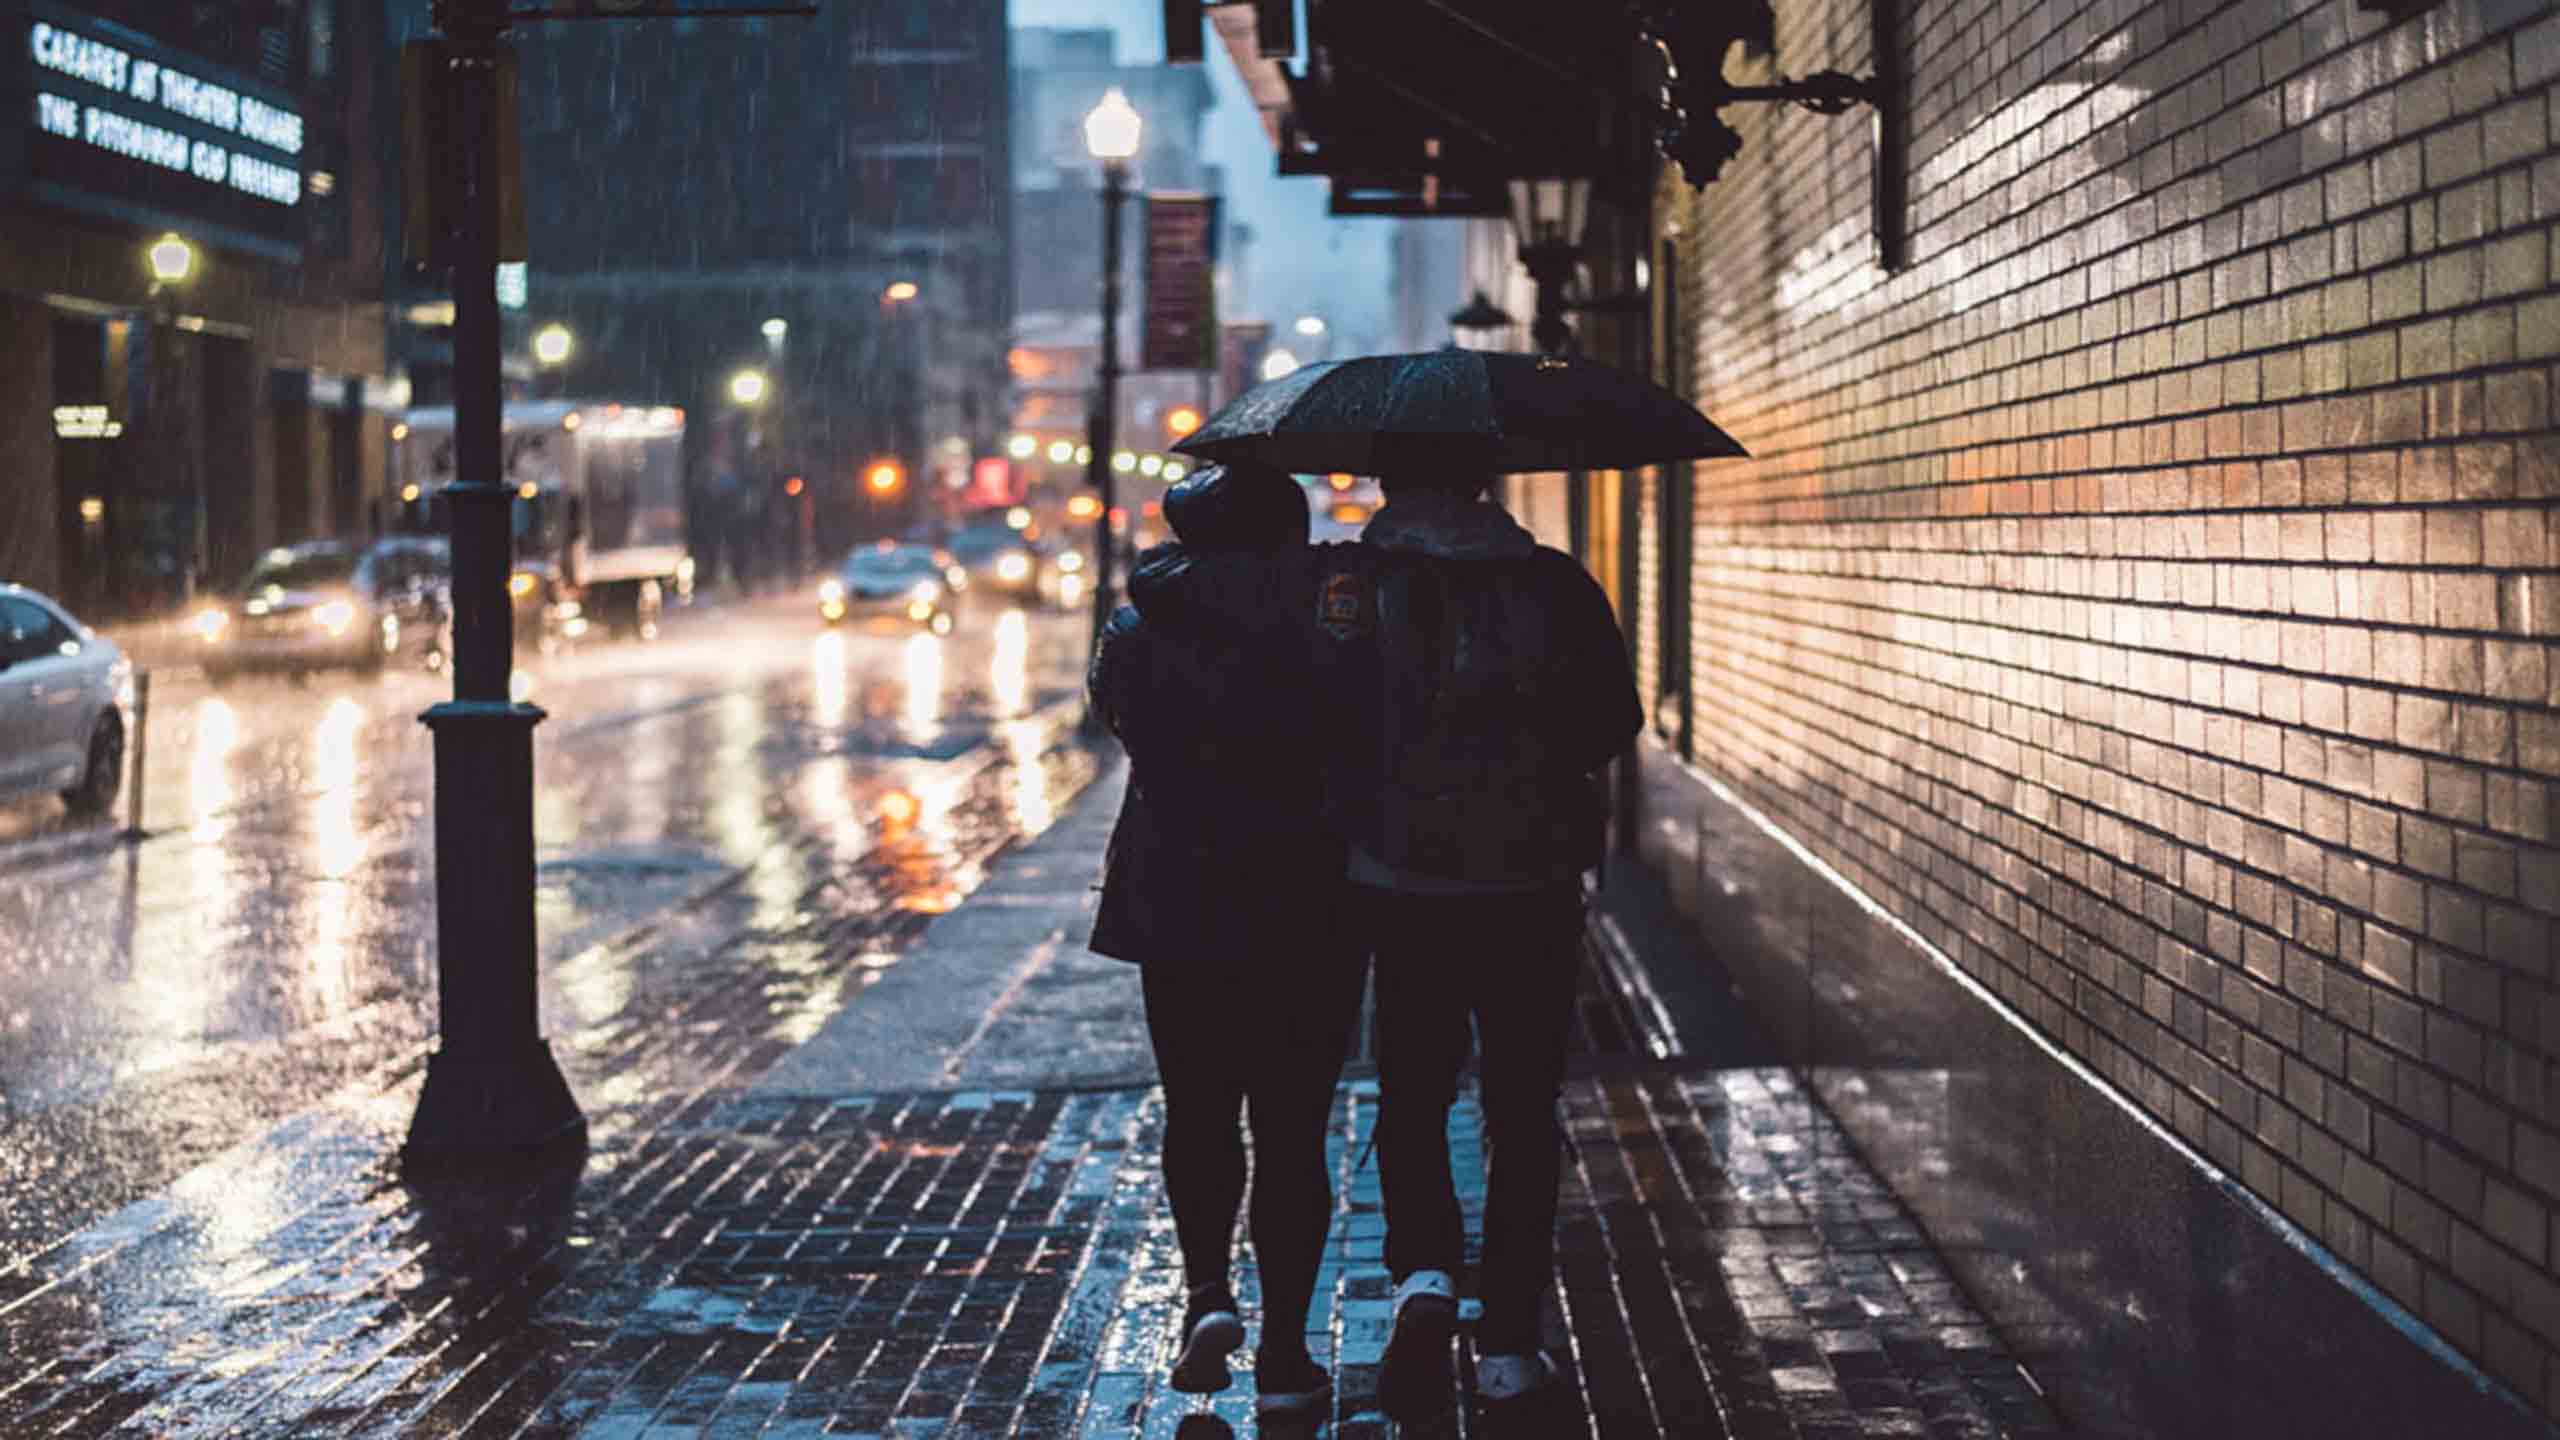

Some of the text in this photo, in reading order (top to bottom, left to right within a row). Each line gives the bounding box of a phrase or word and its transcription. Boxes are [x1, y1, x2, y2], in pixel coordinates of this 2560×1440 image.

[32, 22, 129, 92] CABARET
[130, 60, 159, 102] AT
[38, 92, 78, 139] THE
